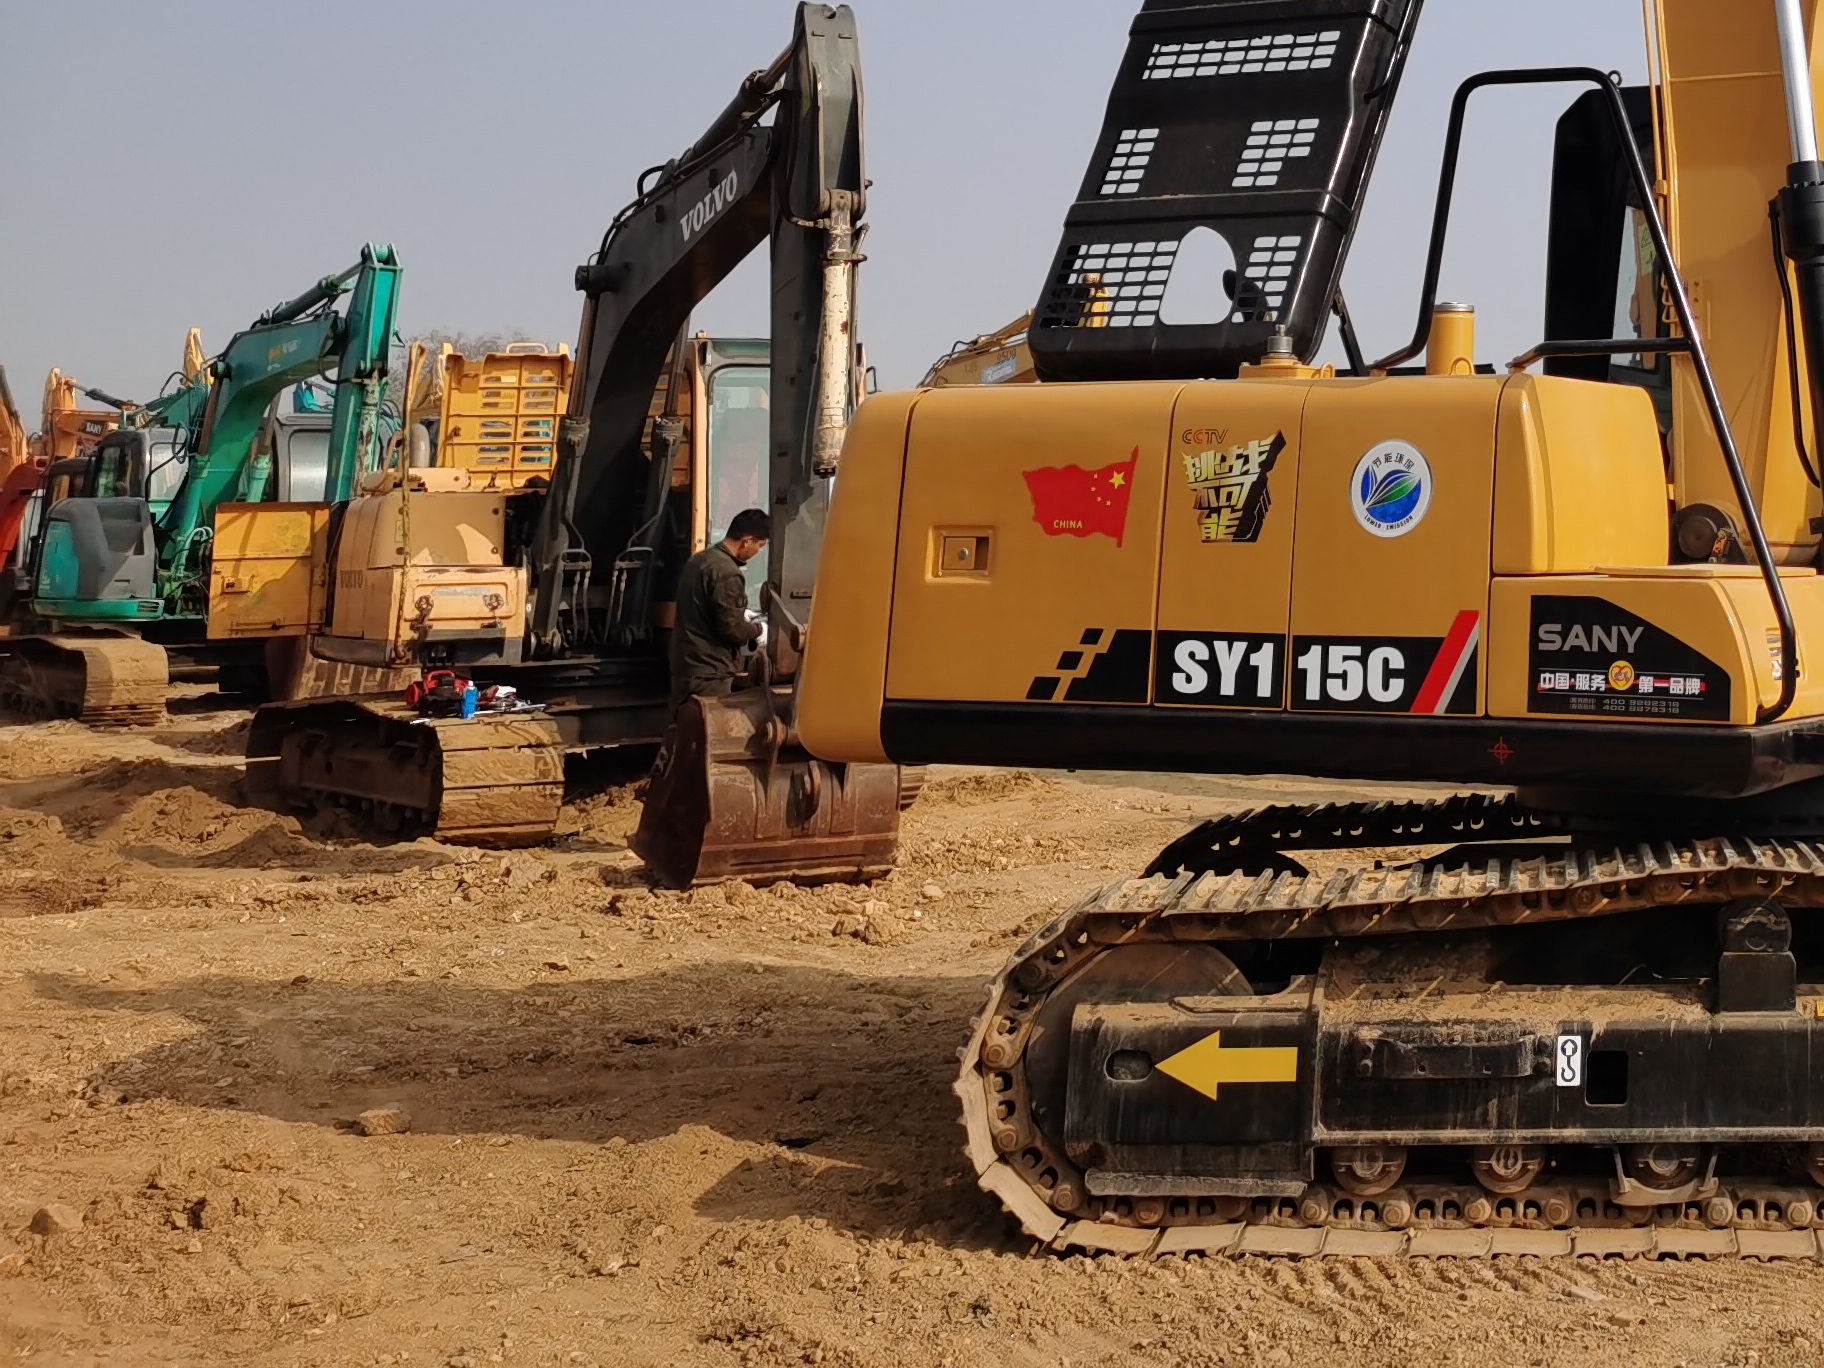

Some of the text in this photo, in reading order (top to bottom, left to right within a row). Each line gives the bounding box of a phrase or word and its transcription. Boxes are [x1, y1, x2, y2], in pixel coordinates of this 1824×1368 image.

[680, 168, 738, 242] VOLVO
[1182, 428, 1228, 445] CCTV
[1053, 519, 1083, 529] CHINA
[1538, 623, 1645, 654] SANY
